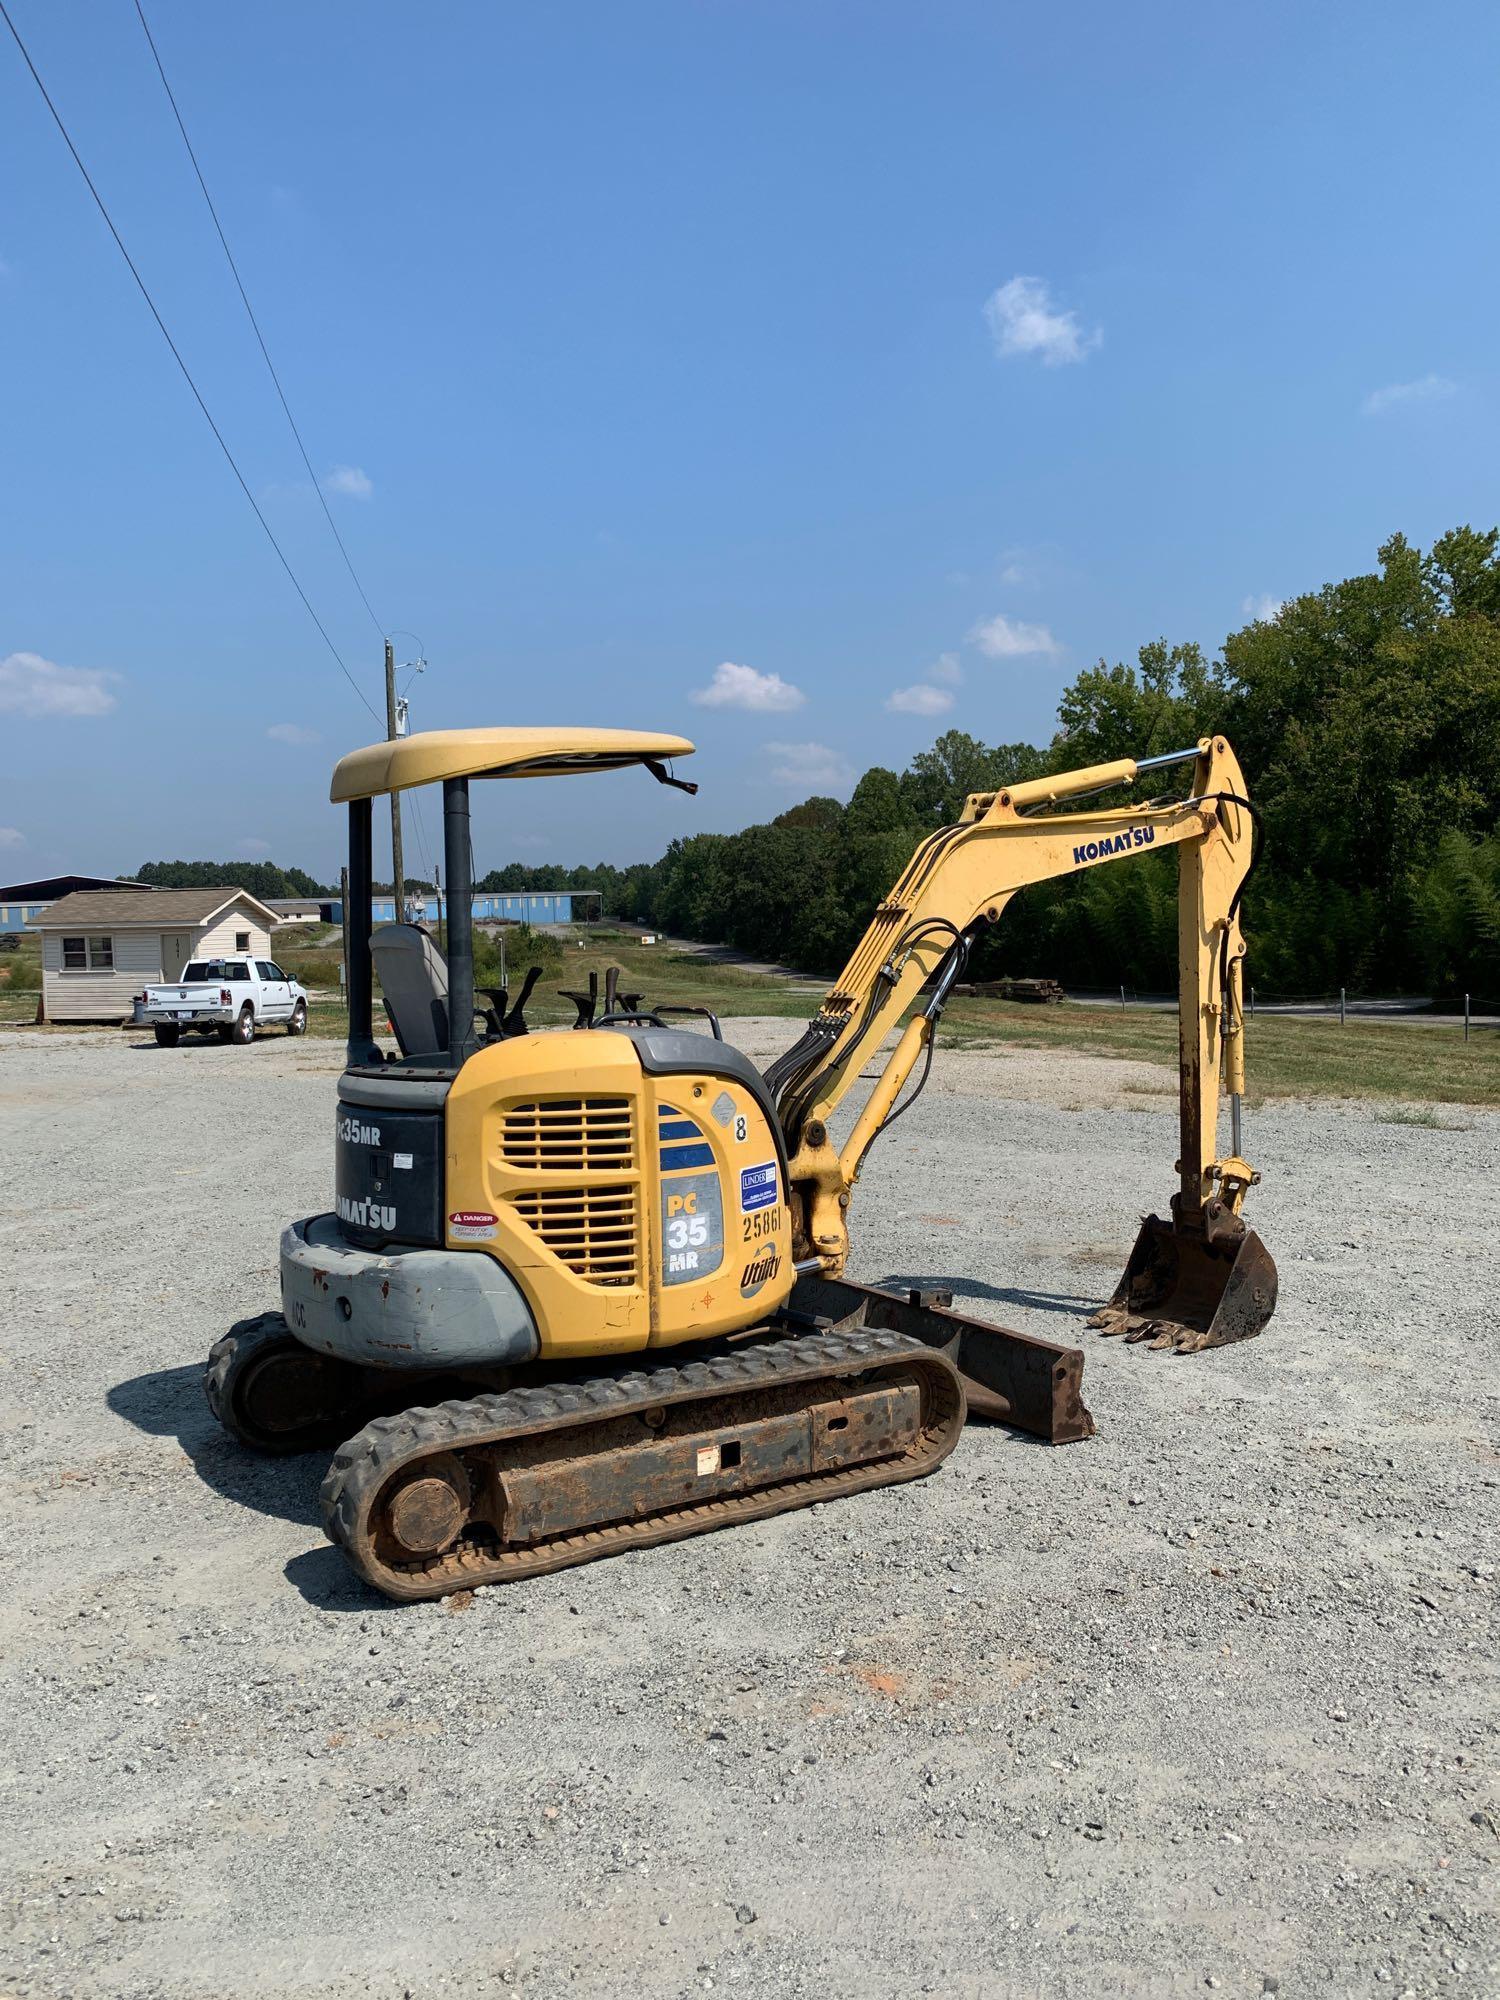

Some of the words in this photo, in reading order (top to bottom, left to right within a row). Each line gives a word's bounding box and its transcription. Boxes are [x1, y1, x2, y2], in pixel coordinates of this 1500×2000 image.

[1073, 825, 1155, 864] KOMATSU
[736, 1117, 746, 1141] 8
[744, 1172, 766, 1187] LINDER
[336, 1195, 397, 1231] OMATSU
[667, 1193, 697, 1217] PC
[668, 1217, 707, 1250] 35
[743, 1207, 781, 1242] 25861
[669, 1251, 698, 1273] MR
[741, 1256, 781, 1288] Utility
